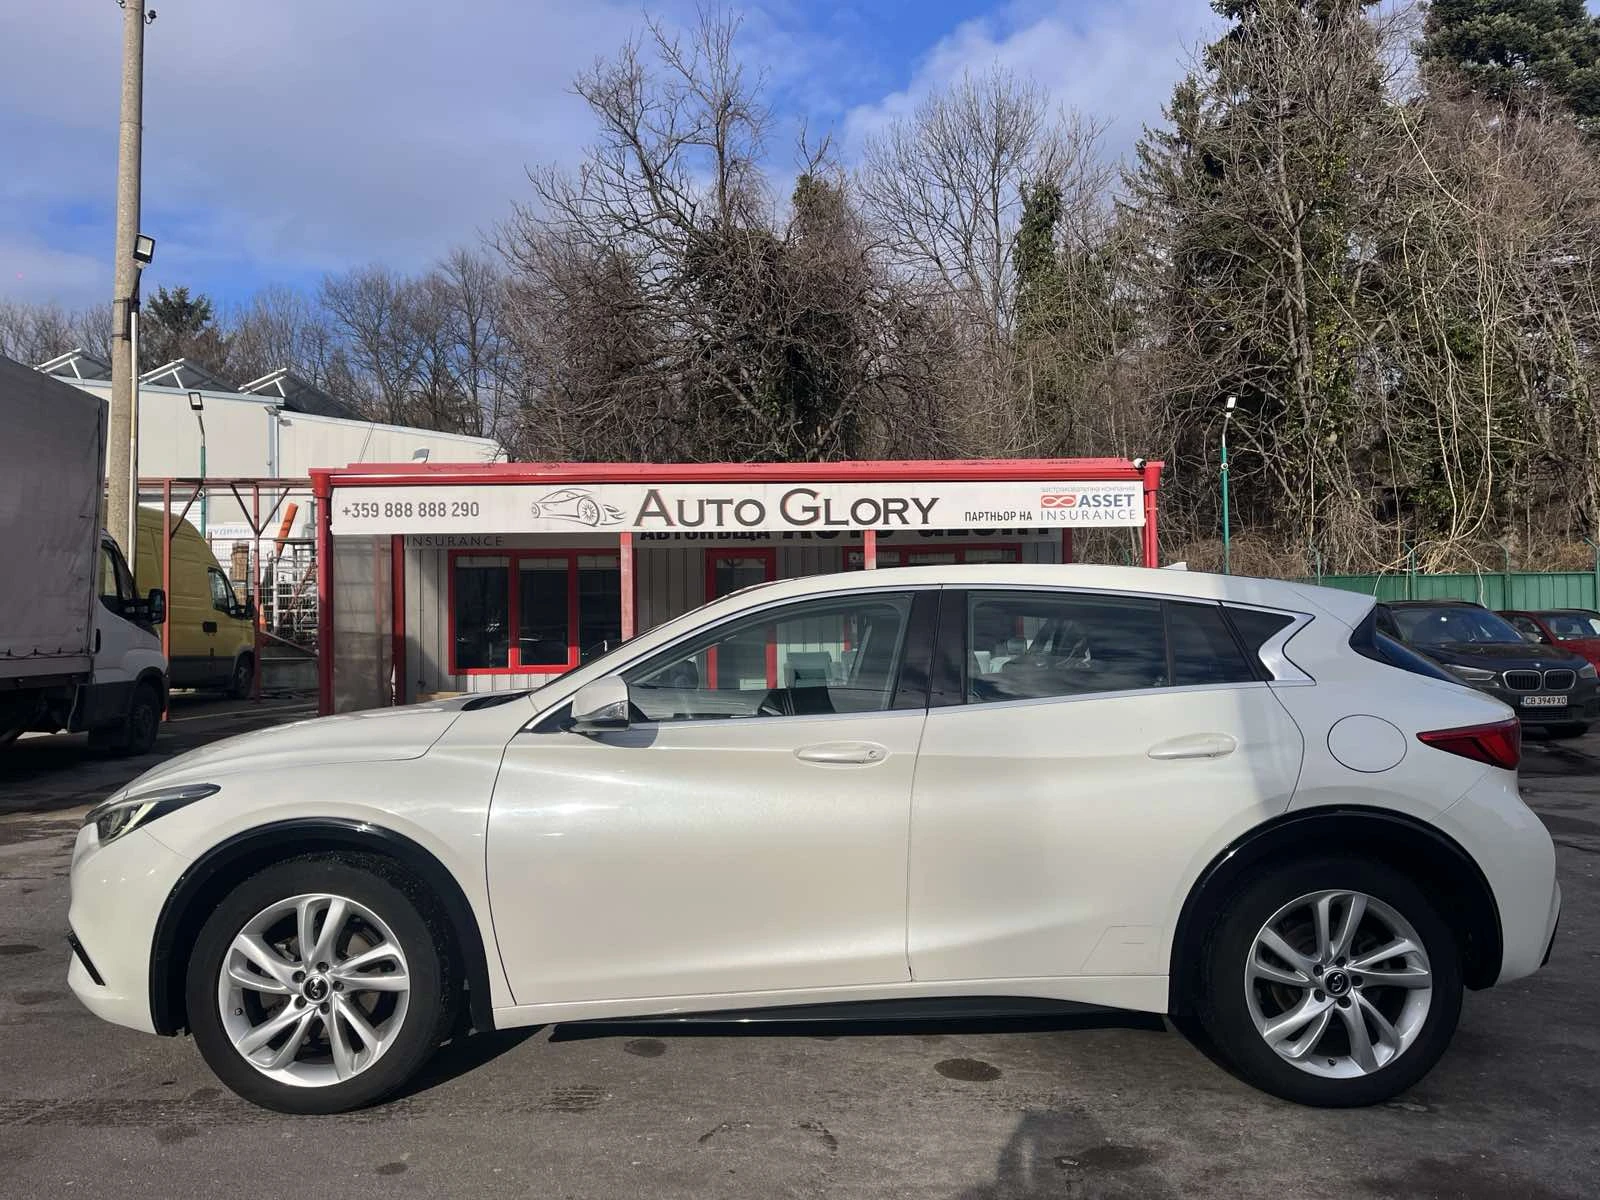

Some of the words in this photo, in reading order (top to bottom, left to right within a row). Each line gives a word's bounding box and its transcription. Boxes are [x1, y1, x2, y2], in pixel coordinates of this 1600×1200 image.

[632, 489, 767, 527] AUTO
[780, 488, 940, 526] GLORY
[1079, 494, 1136, 508] ASSET
[342, 502, 379, 518] +359
[384, 502, 413, 518] 888
[418, 502, 447, 518] 888
[451, 502, 480, 517] 290
[965, 511, 1017, 521] ПАРТНЬОР
[1019, 511, 1033, 521] НА
[1040, 509, 1136, 521] INSURANCE
[406, 535, 505, 547] INSURANCE
